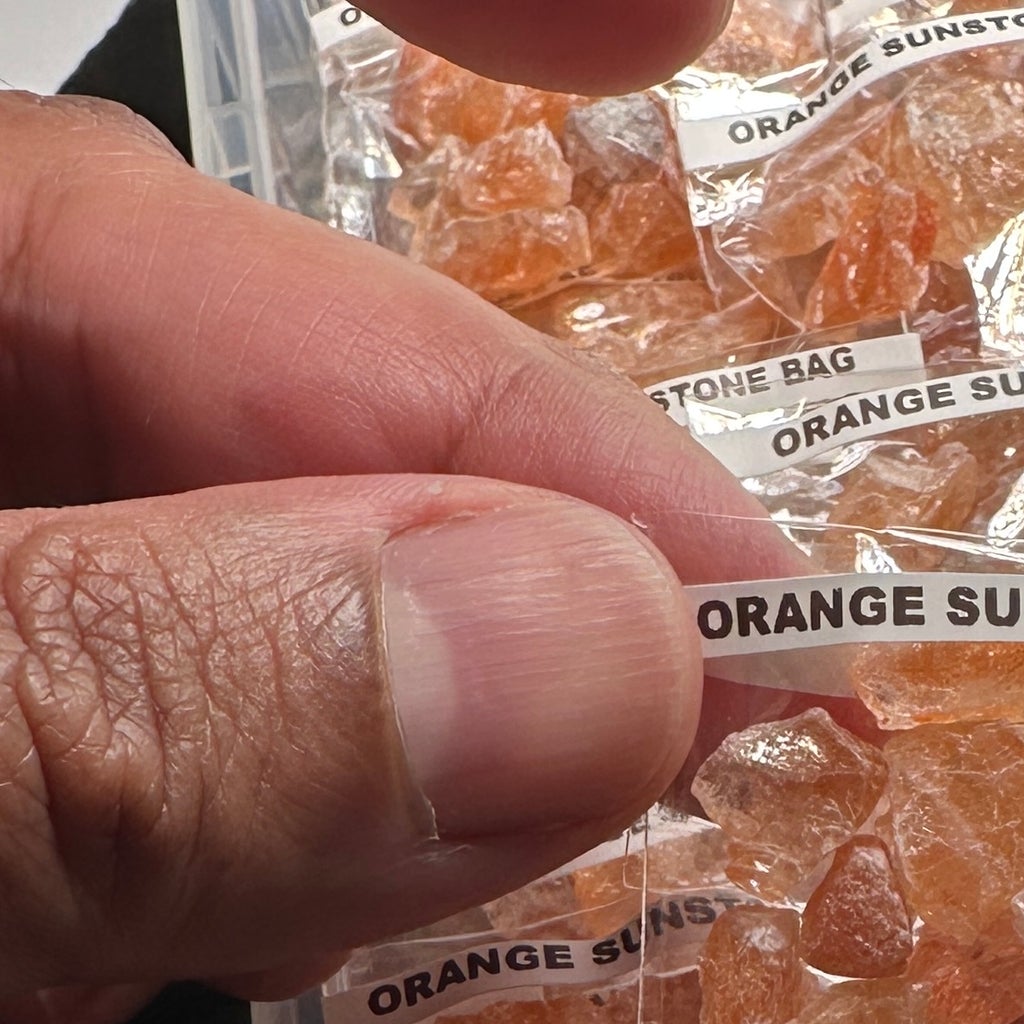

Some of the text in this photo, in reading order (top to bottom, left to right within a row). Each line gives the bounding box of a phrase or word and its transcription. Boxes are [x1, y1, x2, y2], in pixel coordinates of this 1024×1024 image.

[728, 52, 872, 144] ORANGE
[780, 346, 856, 386] BAG
[772, 382, 956, 457] ORANGE
[697, 586, 925, 639] ORANGE
[367, 945, 574, 1016] ORANGE
